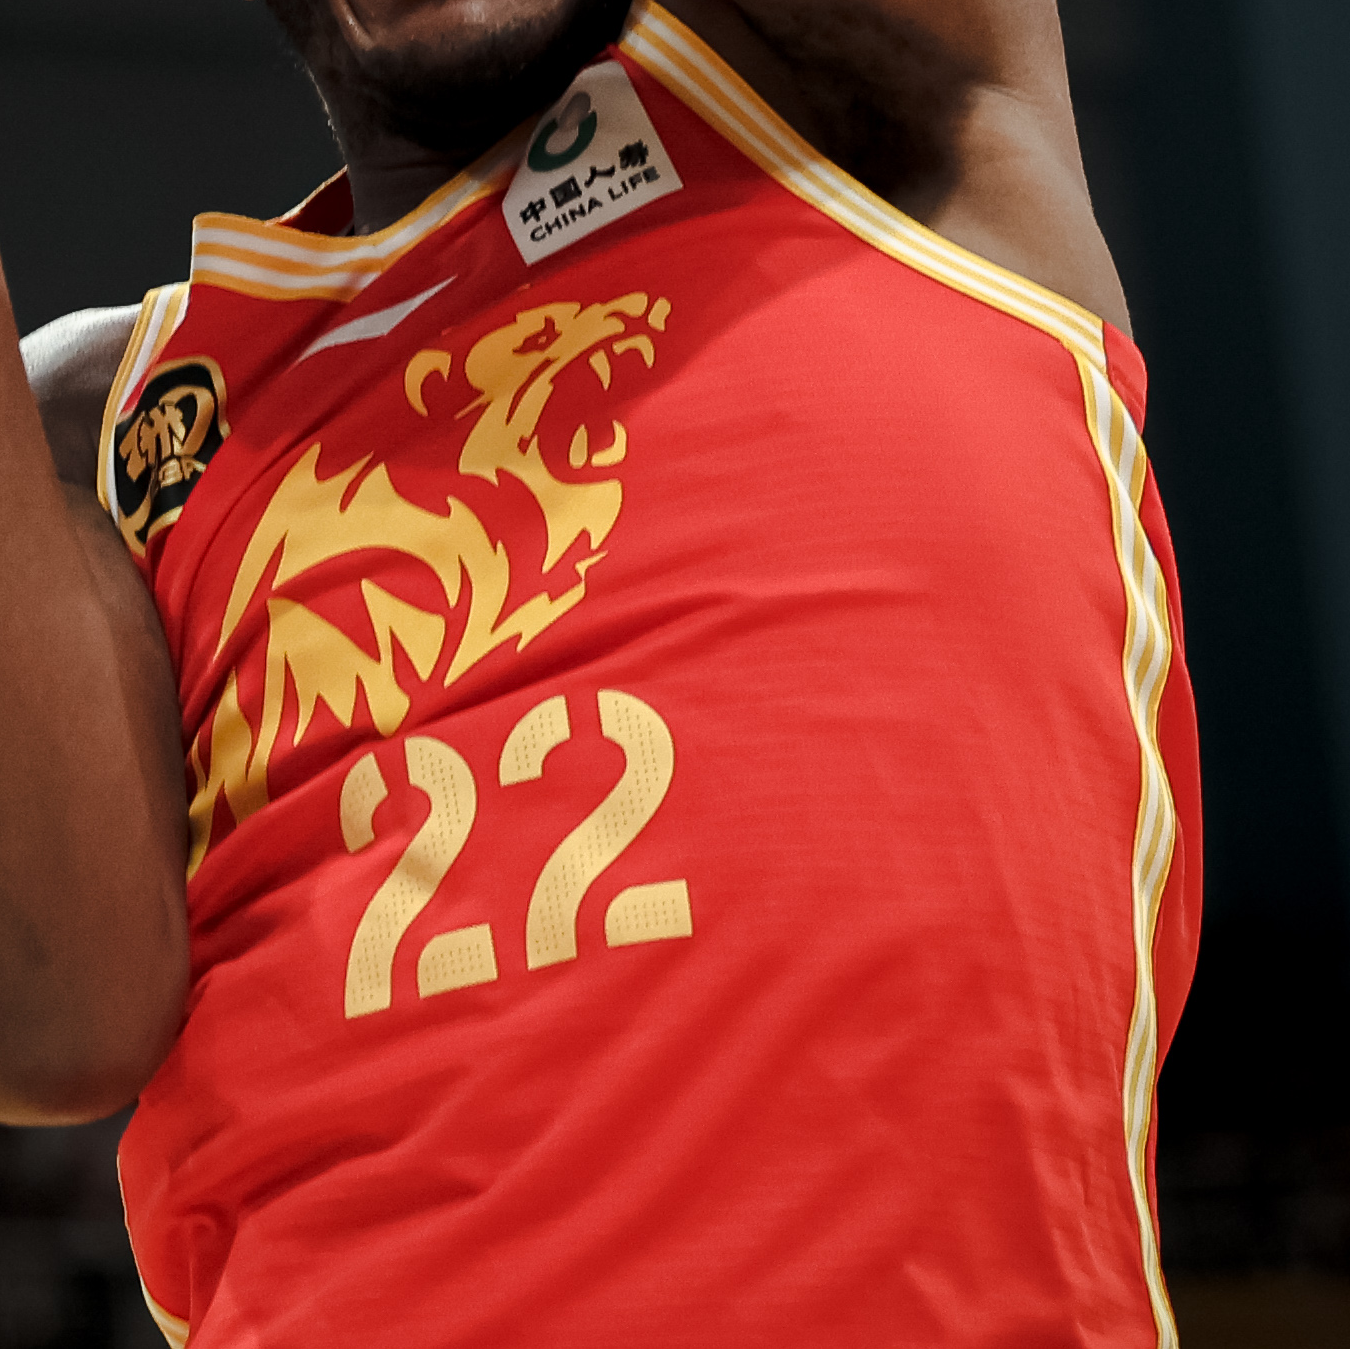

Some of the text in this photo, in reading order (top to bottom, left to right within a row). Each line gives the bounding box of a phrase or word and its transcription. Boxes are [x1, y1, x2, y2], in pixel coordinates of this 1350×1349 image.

[519, 139, 649, 226] 中国人寿
[529, 165, 661, 243] CHINA LIFE
[339, 688, 693, 1020] 22
